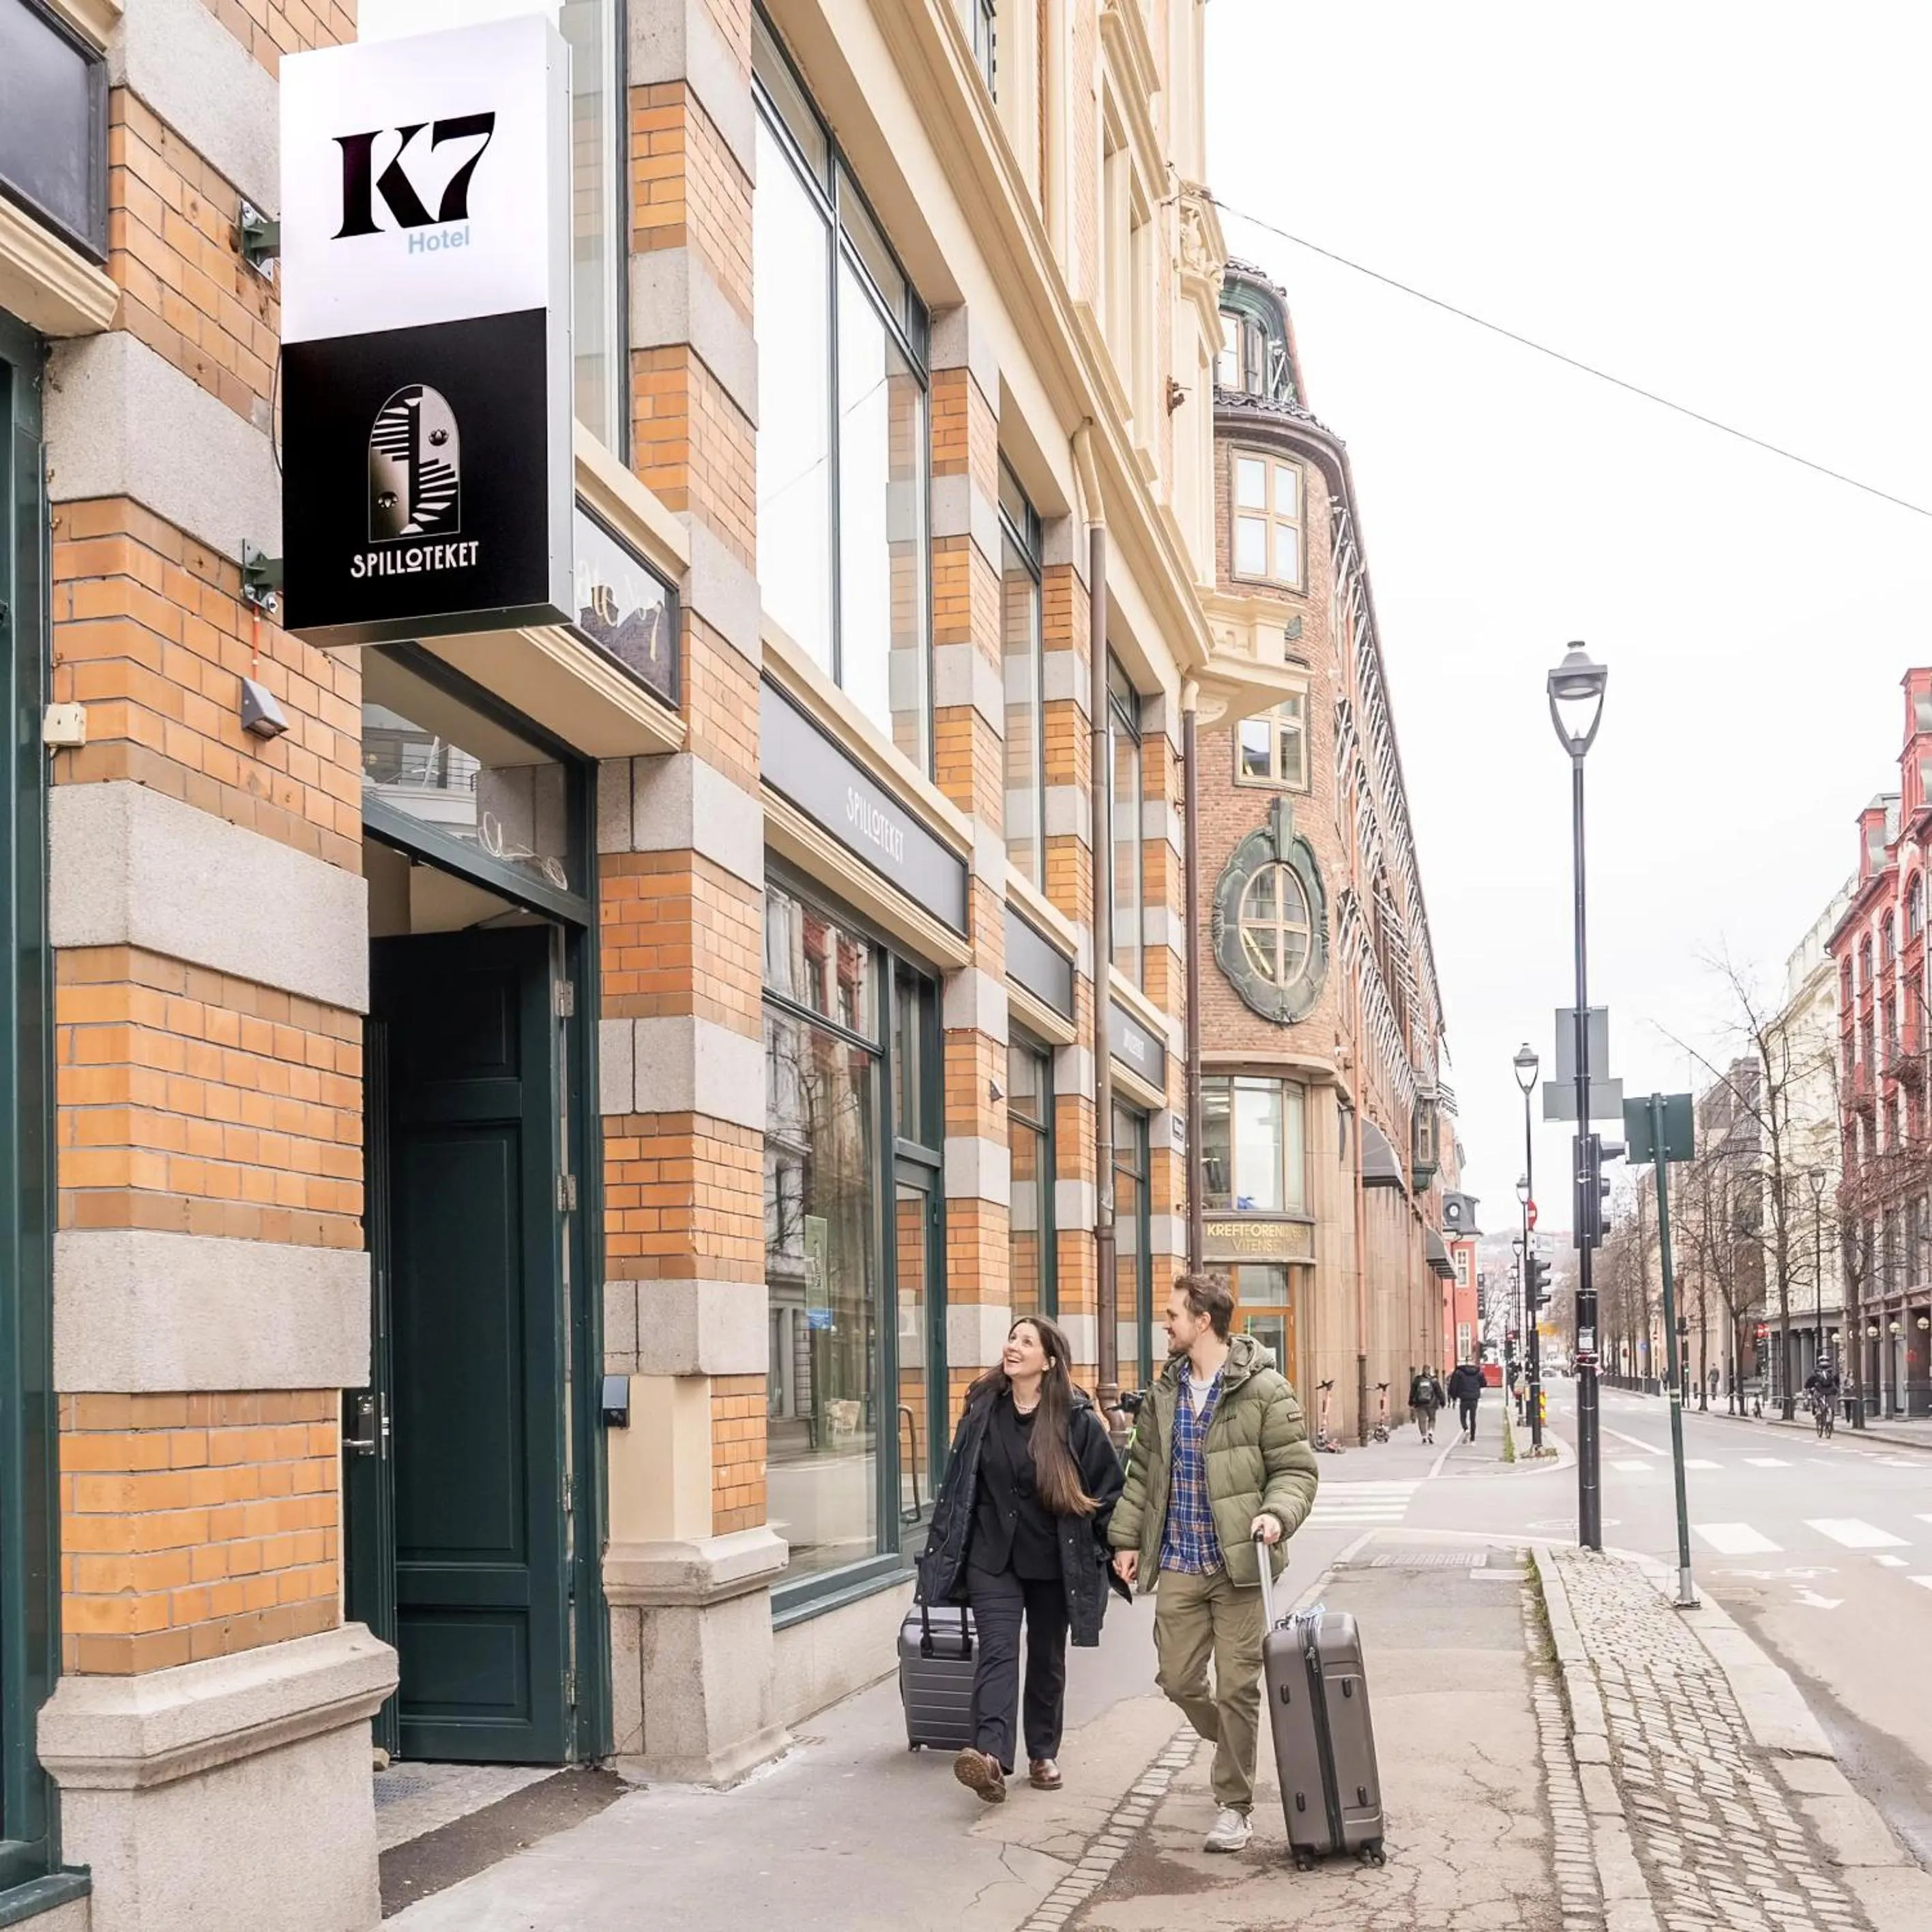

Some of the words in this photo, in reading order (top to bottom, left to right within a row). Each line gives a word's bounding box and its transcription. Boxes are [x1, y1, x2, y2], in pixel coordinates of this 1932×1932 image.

[330, 111, 496, 240] K7
[408, 225, 471, 254] Hotel
[350, 541, 479, 579] SPILLOTEKET
[846, 786, 904, 865] SPILLOTEKET
